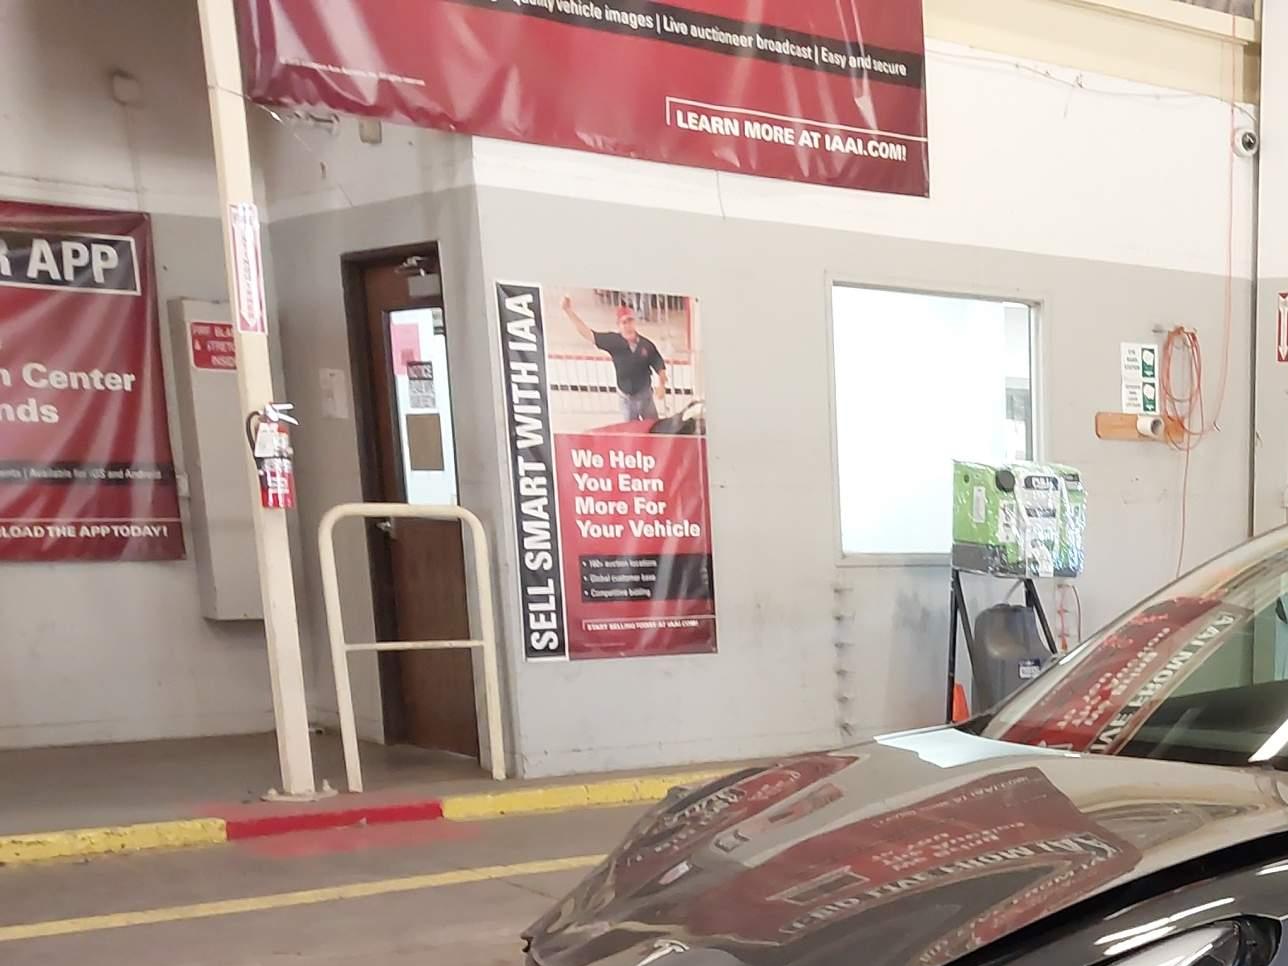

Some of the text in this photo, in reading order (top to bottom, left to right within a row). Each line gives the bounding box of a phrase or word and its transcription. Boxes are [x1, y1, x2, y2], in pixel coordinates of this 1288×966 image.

[556, 0, 602, 20] vehicle
[604, 4, 654, 30] images
[663, 15, 688, 35] Live
[690, 24, 753, 48] auctioneer
[756, 33, 812, 60] broadcast
[821, 46, 847, 69] Easy
[849, 51, 872, 71] and
[872, 60, 907, 77] secure
[676, 109, 907, 162] LEARN MORE AT IAAI.COM!
[26, 237, 119, 283] APP
[21, 362, 136, 392] Center
[505, 293, 559, 650] SELL SMART WITH IAA
[571, 449, 656, 472] We Help
[573, 473, 664, 492] You Earn
[575, 496, 667, 515] More For
[0, 525, 168, 538] LOAD THE APP TODAY!
[576, 519, 701, 538] Your Vehicle
